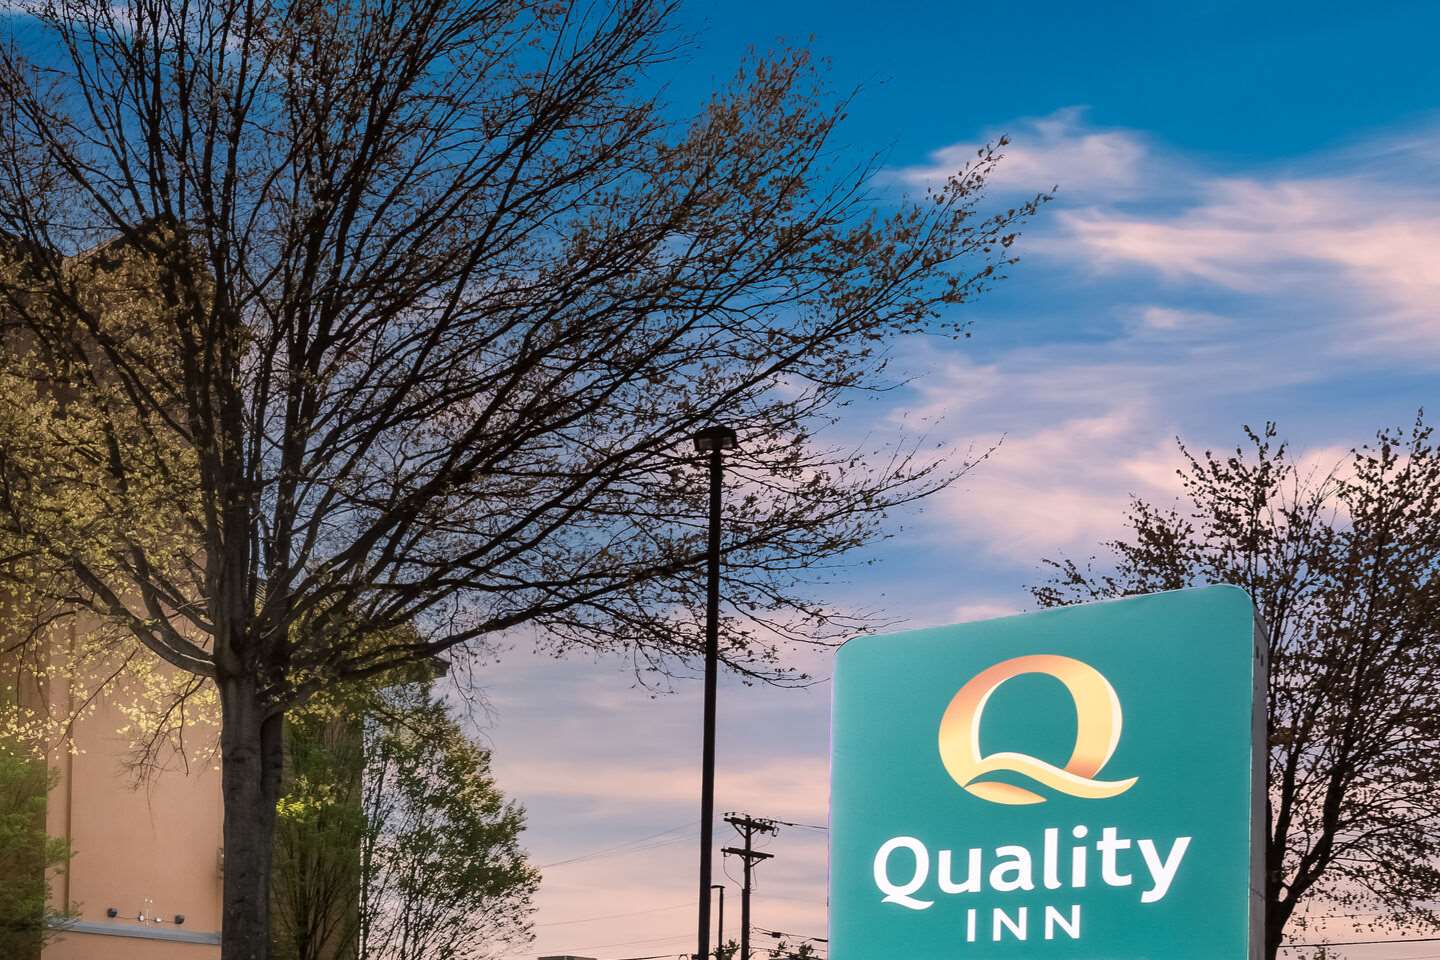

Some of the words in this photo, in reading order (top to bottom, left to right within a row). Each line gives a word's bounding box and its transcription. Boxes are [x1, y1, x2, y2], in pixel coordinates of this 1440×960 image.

[938, 654, 1139, 805] Q
[873, 824, 1192, 910] Quality
[966, 904, 1081, 943] INN
